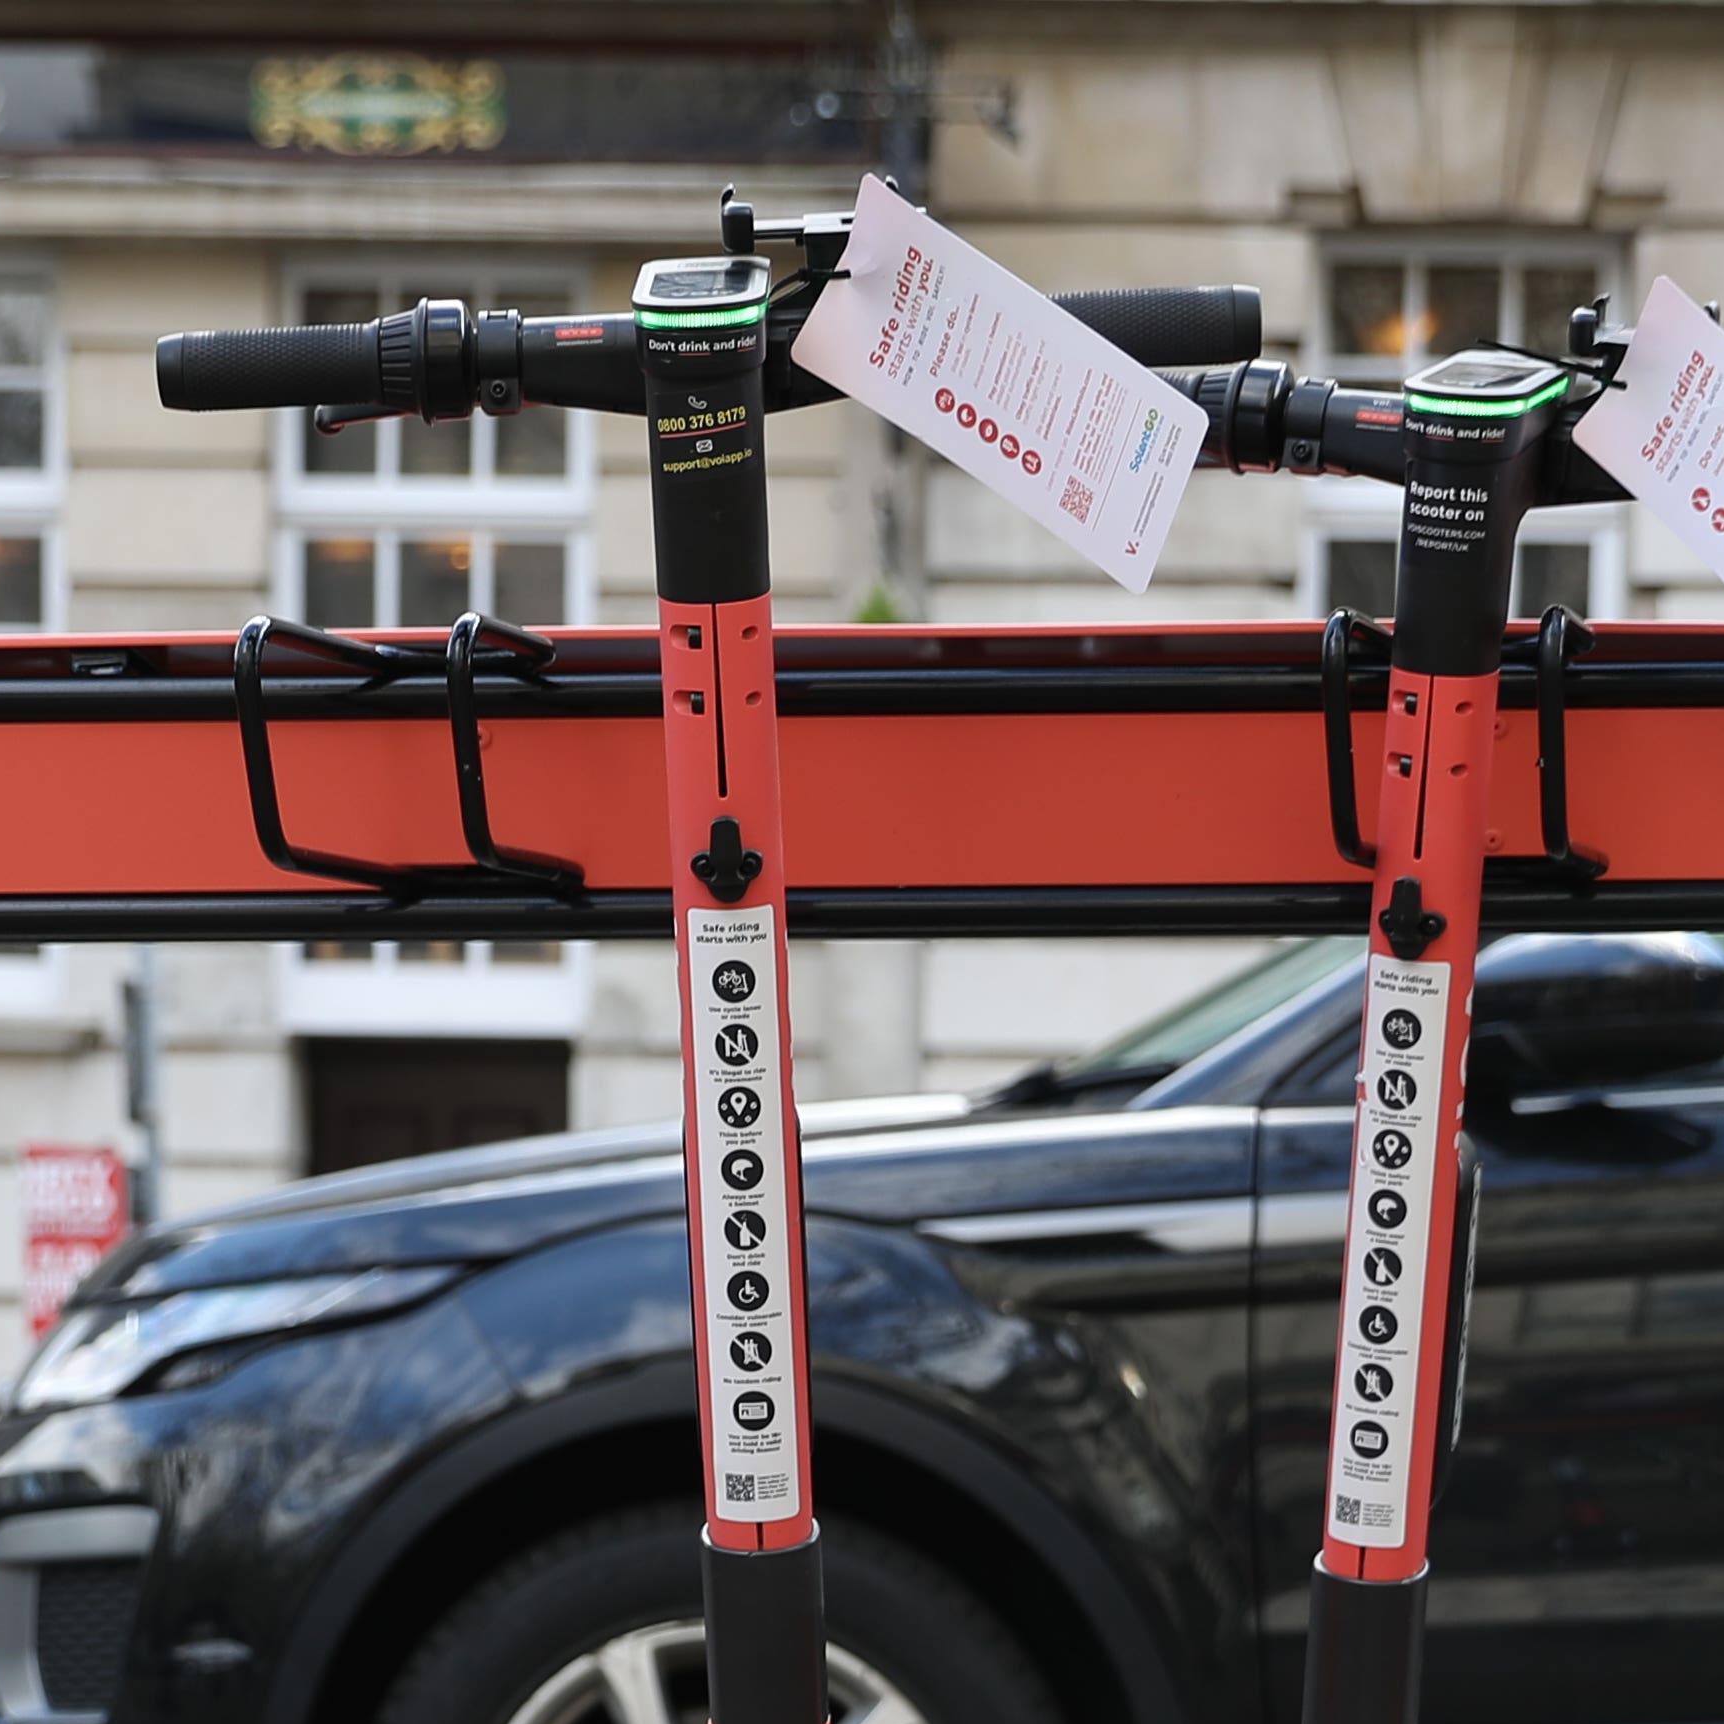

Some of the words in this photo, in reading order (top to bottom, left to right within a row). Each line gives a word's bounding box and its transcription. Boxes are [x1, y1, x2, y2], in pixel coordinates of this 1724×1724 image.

[869, 318, 899, 368] Safe
[892, 246, 922, 313] riding
[887, 331, 913, 379] starts
[906, 294, 924, 330] with
[917, 259, 934, 295] you.
[649, 338, 675, 351] Don't
[678, 339, 710, 351] drink
[713, 340, 734, 350] and
[737, 336, 757, 348] ride!
[912, 350, 921, 361] TO
[918, 325, 929, 346] RIDE
[929, 332, 951, 378] Please
[1641, 415, 1673, 462] Safe
[1670, 350, 1705, 413] riding
[657, 415, 686, 432] 0800
[689, 412, 714, 430] 376
[718, 406, 746, 425] 8179
[1129, 408, 1159, 474] SolentGO
[1426, 424, 1454, 437] drink
[1457, 429, 1479, 439] and
[1482, 428, 1506, 439] ride!
[1655, 430, 1684, 474] starts
[1679, 397, 1699, 430] with
[1698, 450, 1713, 470] Do
[1410, 481, 1455, 501] Report
[1460, 487, 1488, 503] this
[1410, 502, 1461, 520] scooter
[1465, 509, 1484, 521] on
[696, 935, 723, 944] starts
[726, 934, 747, 944] with
[750, 933, 766, 943] you
[703, 923, 725, 933] Safe
[728, 922, 759, 935] riding
[1374, 981, 1396, 992] starts
[1398, 985, 1419, 994] with
[1421, 988, 1439, 997] you
[1380, 970, 1400, 981] Safe
[1402, 974, 1432, 986] riding
